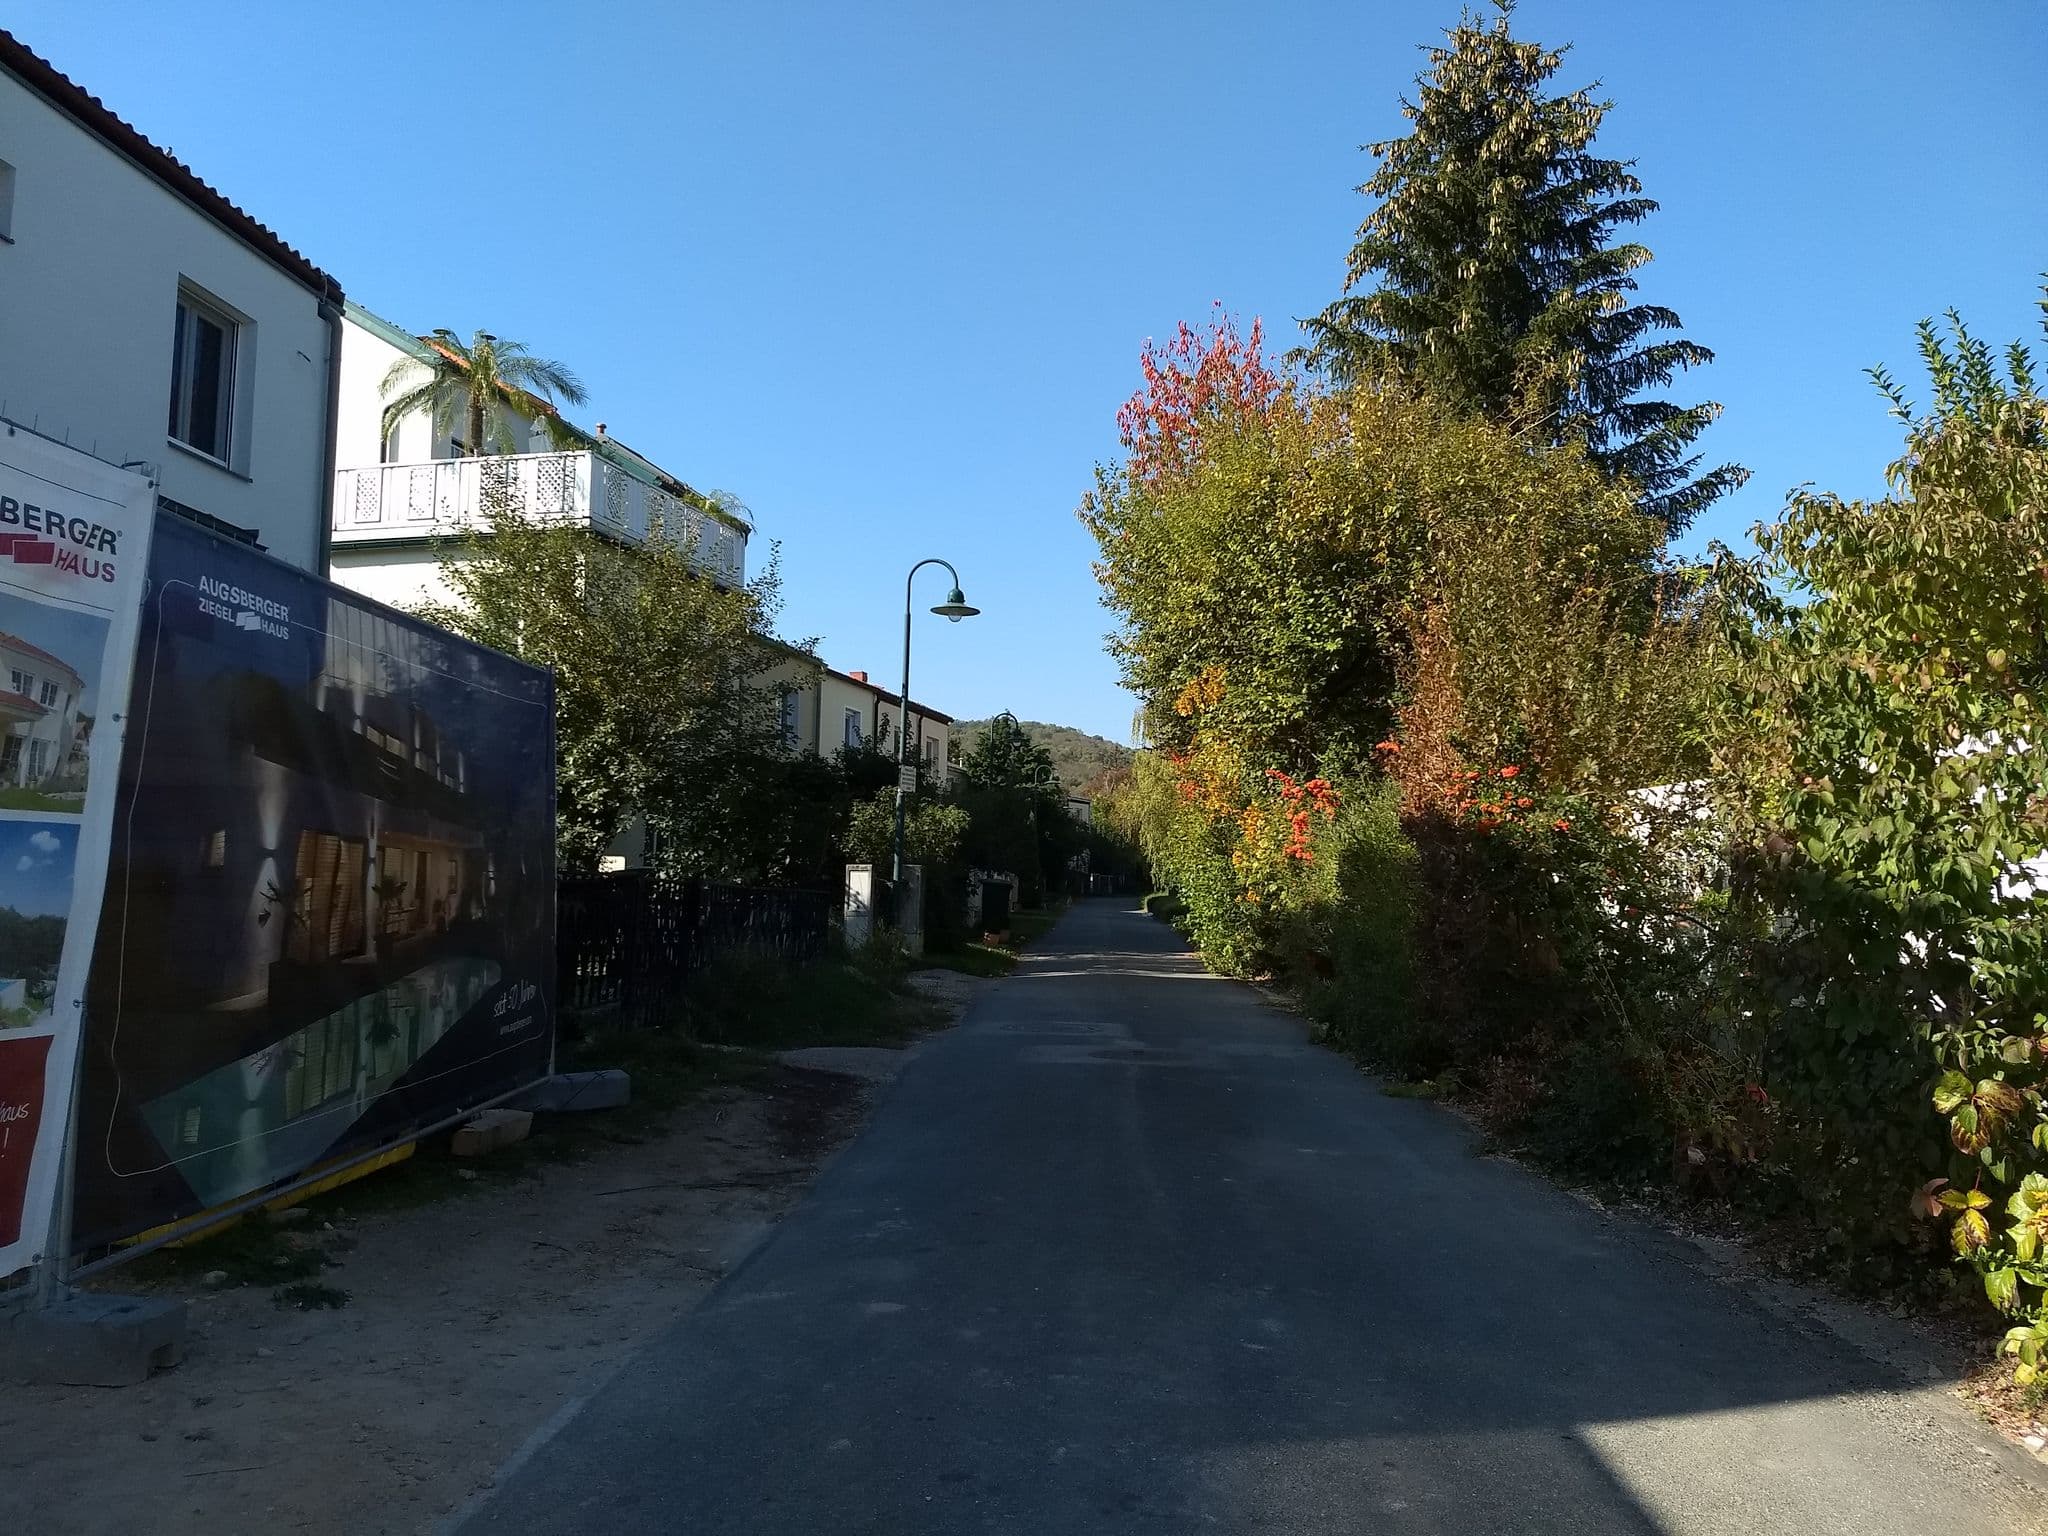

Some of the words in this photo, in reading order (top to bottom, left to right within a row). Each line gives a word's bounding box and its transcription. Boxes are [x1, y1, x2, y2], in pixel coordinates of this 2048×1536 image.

[54, 548, 116, 583] HAUS
[198, 575, 289, 622] AUGSBERGER
[198, 597, 235, 622] ZIEGEL
[260, 618, 289, 640] HAUS
